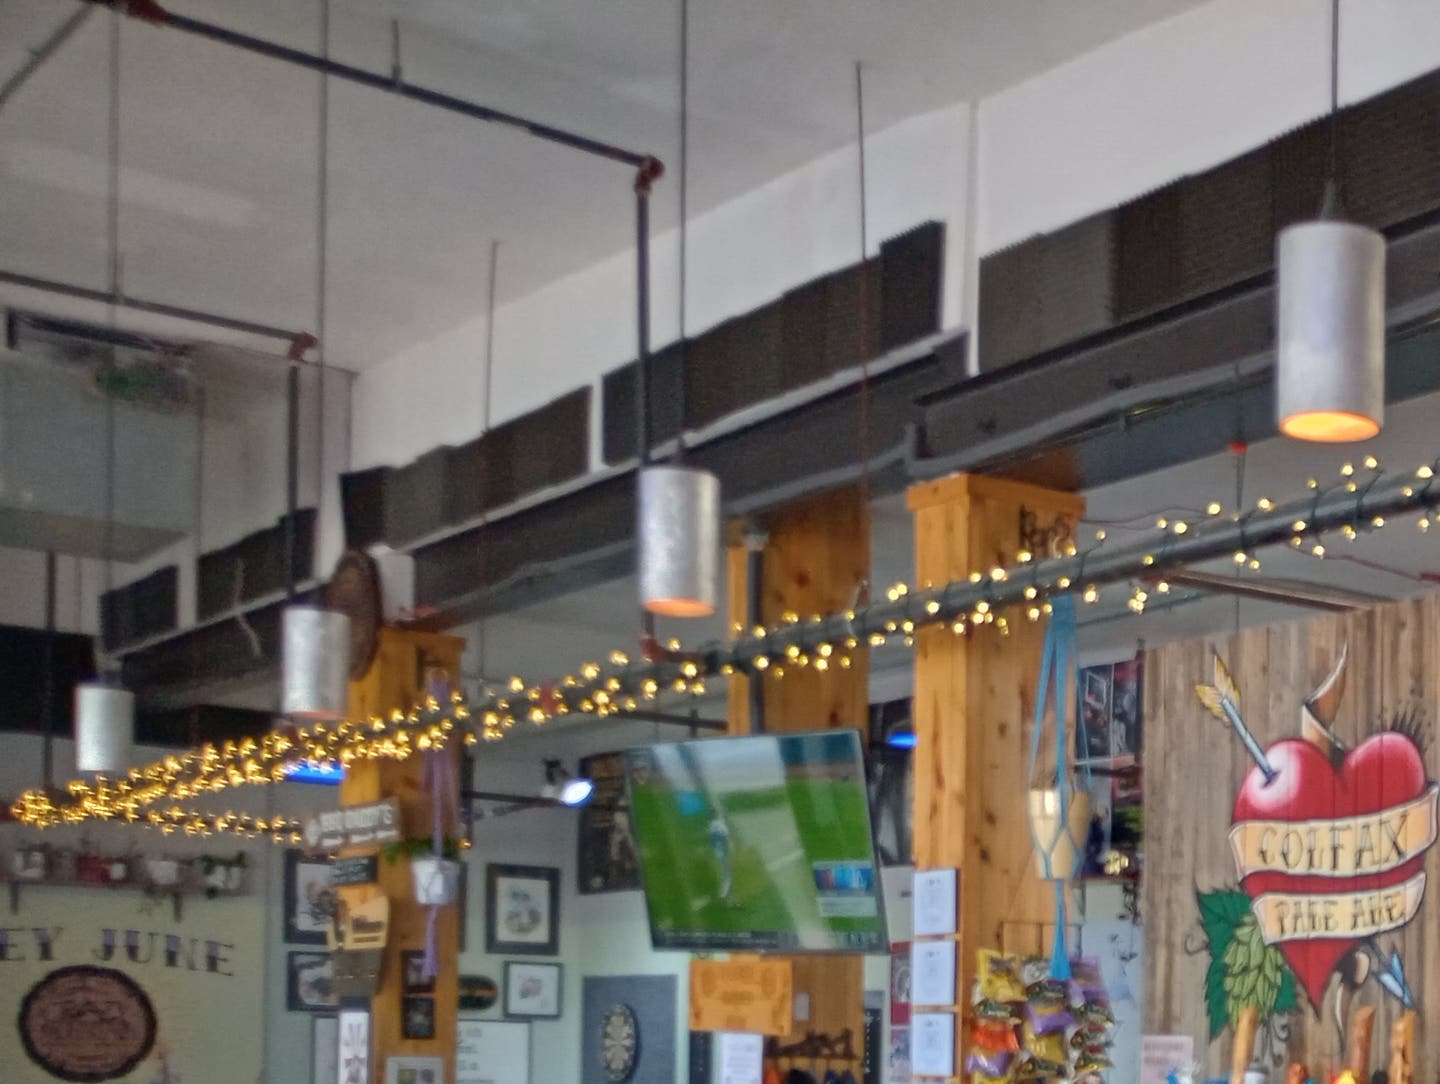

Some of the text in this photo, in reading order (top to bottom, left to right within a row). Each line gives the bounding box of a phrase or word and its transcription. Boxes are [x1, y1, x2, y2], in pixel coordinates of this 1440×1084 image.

[1258, 814, 1410, 871] COLFAX
[1274, 896, 1404, 934] PALE ALE
[93, 927, 236, 977] JUNE
